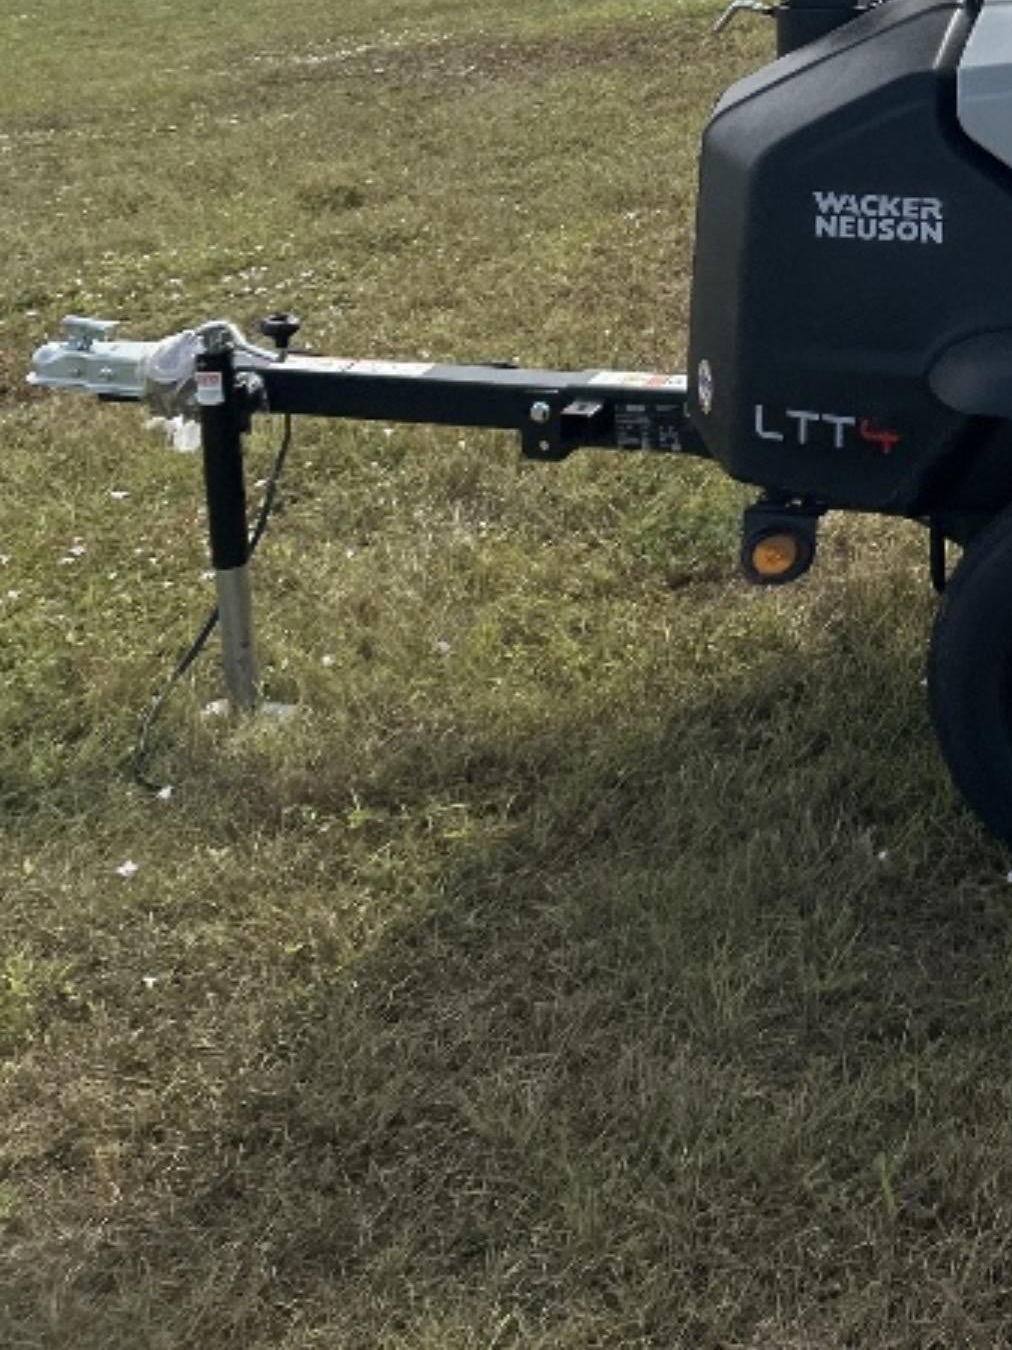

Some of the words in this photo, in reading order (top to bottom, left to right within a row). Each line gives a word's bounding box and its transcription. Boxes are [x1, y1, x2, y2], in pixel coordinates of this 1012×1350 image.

[812, 191, 943, 220] WACKER
[815, 215, 943, 244] NEUSON
[755, 404, 899, 454] LTT4
